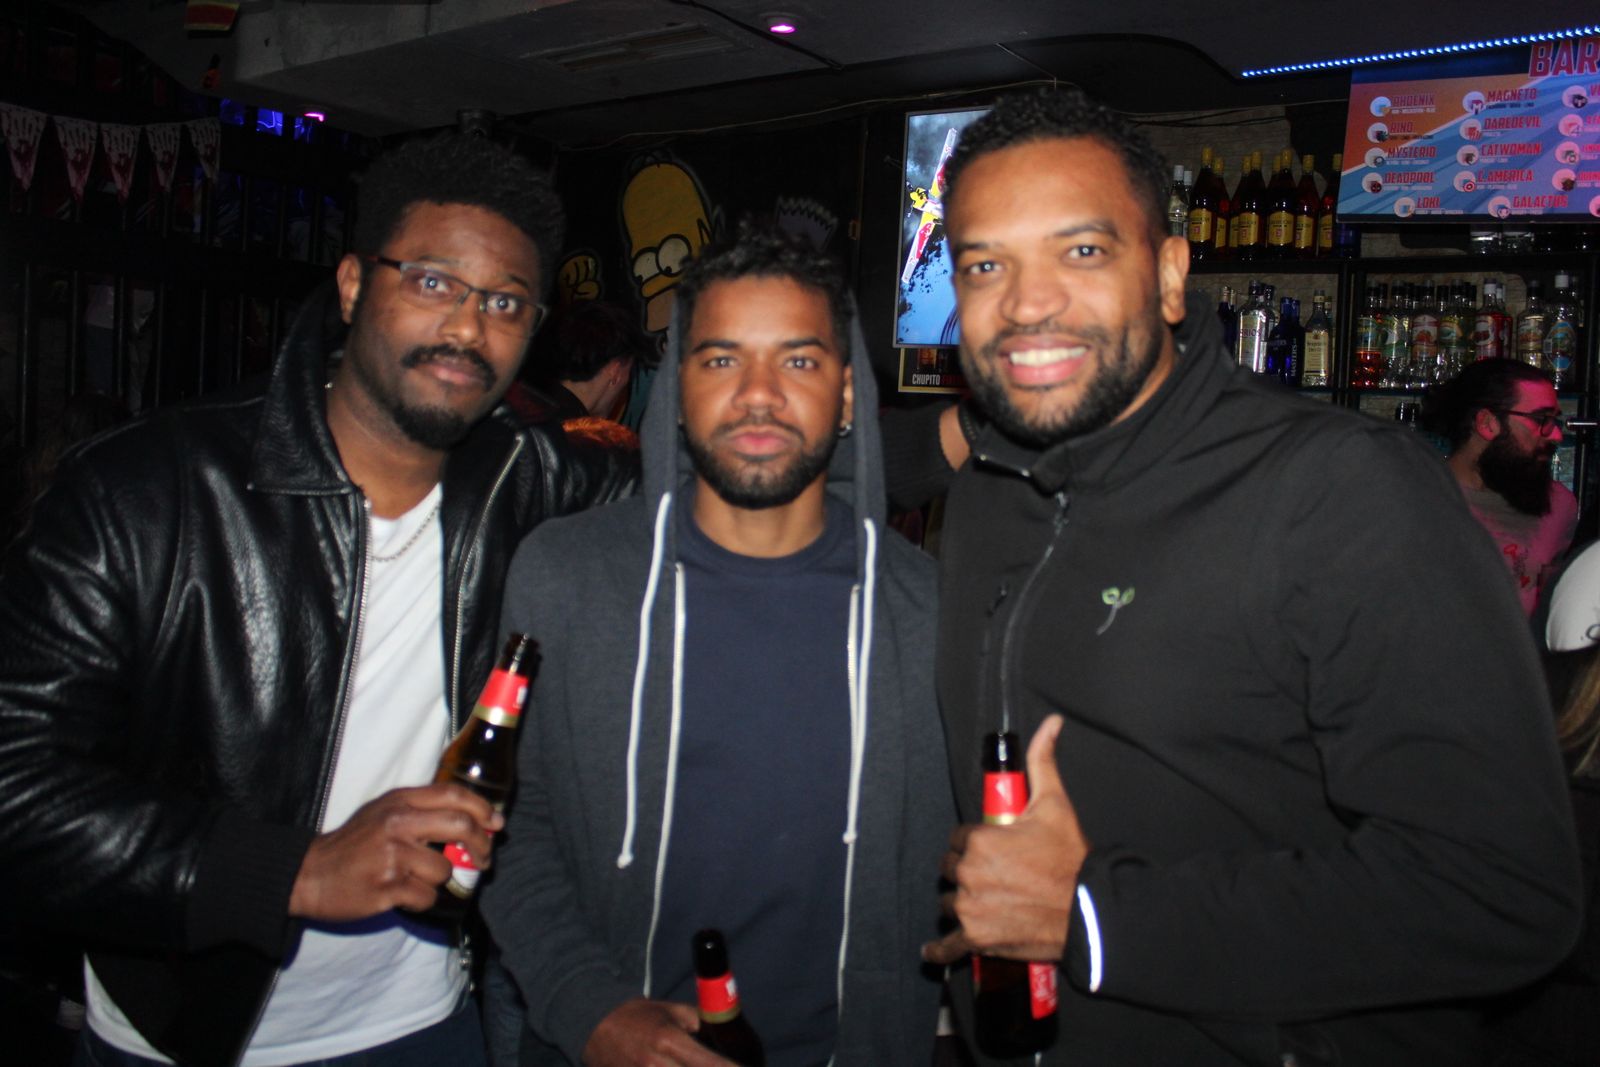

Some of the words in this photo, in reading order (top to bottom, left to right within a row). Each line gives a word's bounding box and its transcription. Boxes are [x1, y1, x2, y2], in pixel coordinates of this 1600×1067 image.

[1529, 40, 1599, 77] BAR
[1392, 94, 1434, 107] PHOENIX
[1487, 87, 1537, 101] MAGNETO
[1391, 121, 1413, 133] RINO
[1484, 115, 1540, 129] DAREDEVIL
[1387, 146, 1436, 158] MYSTERIO
[1481, 143, 1541, 156] CATWOMAN
[1384, 171, 1434, 183] DEADPOOL
[1416, 196, 1440, 208] LOKI
[1512, 195, 1568, 208] GALACTUS
[912, 373, 941, 386] CHUPITO
